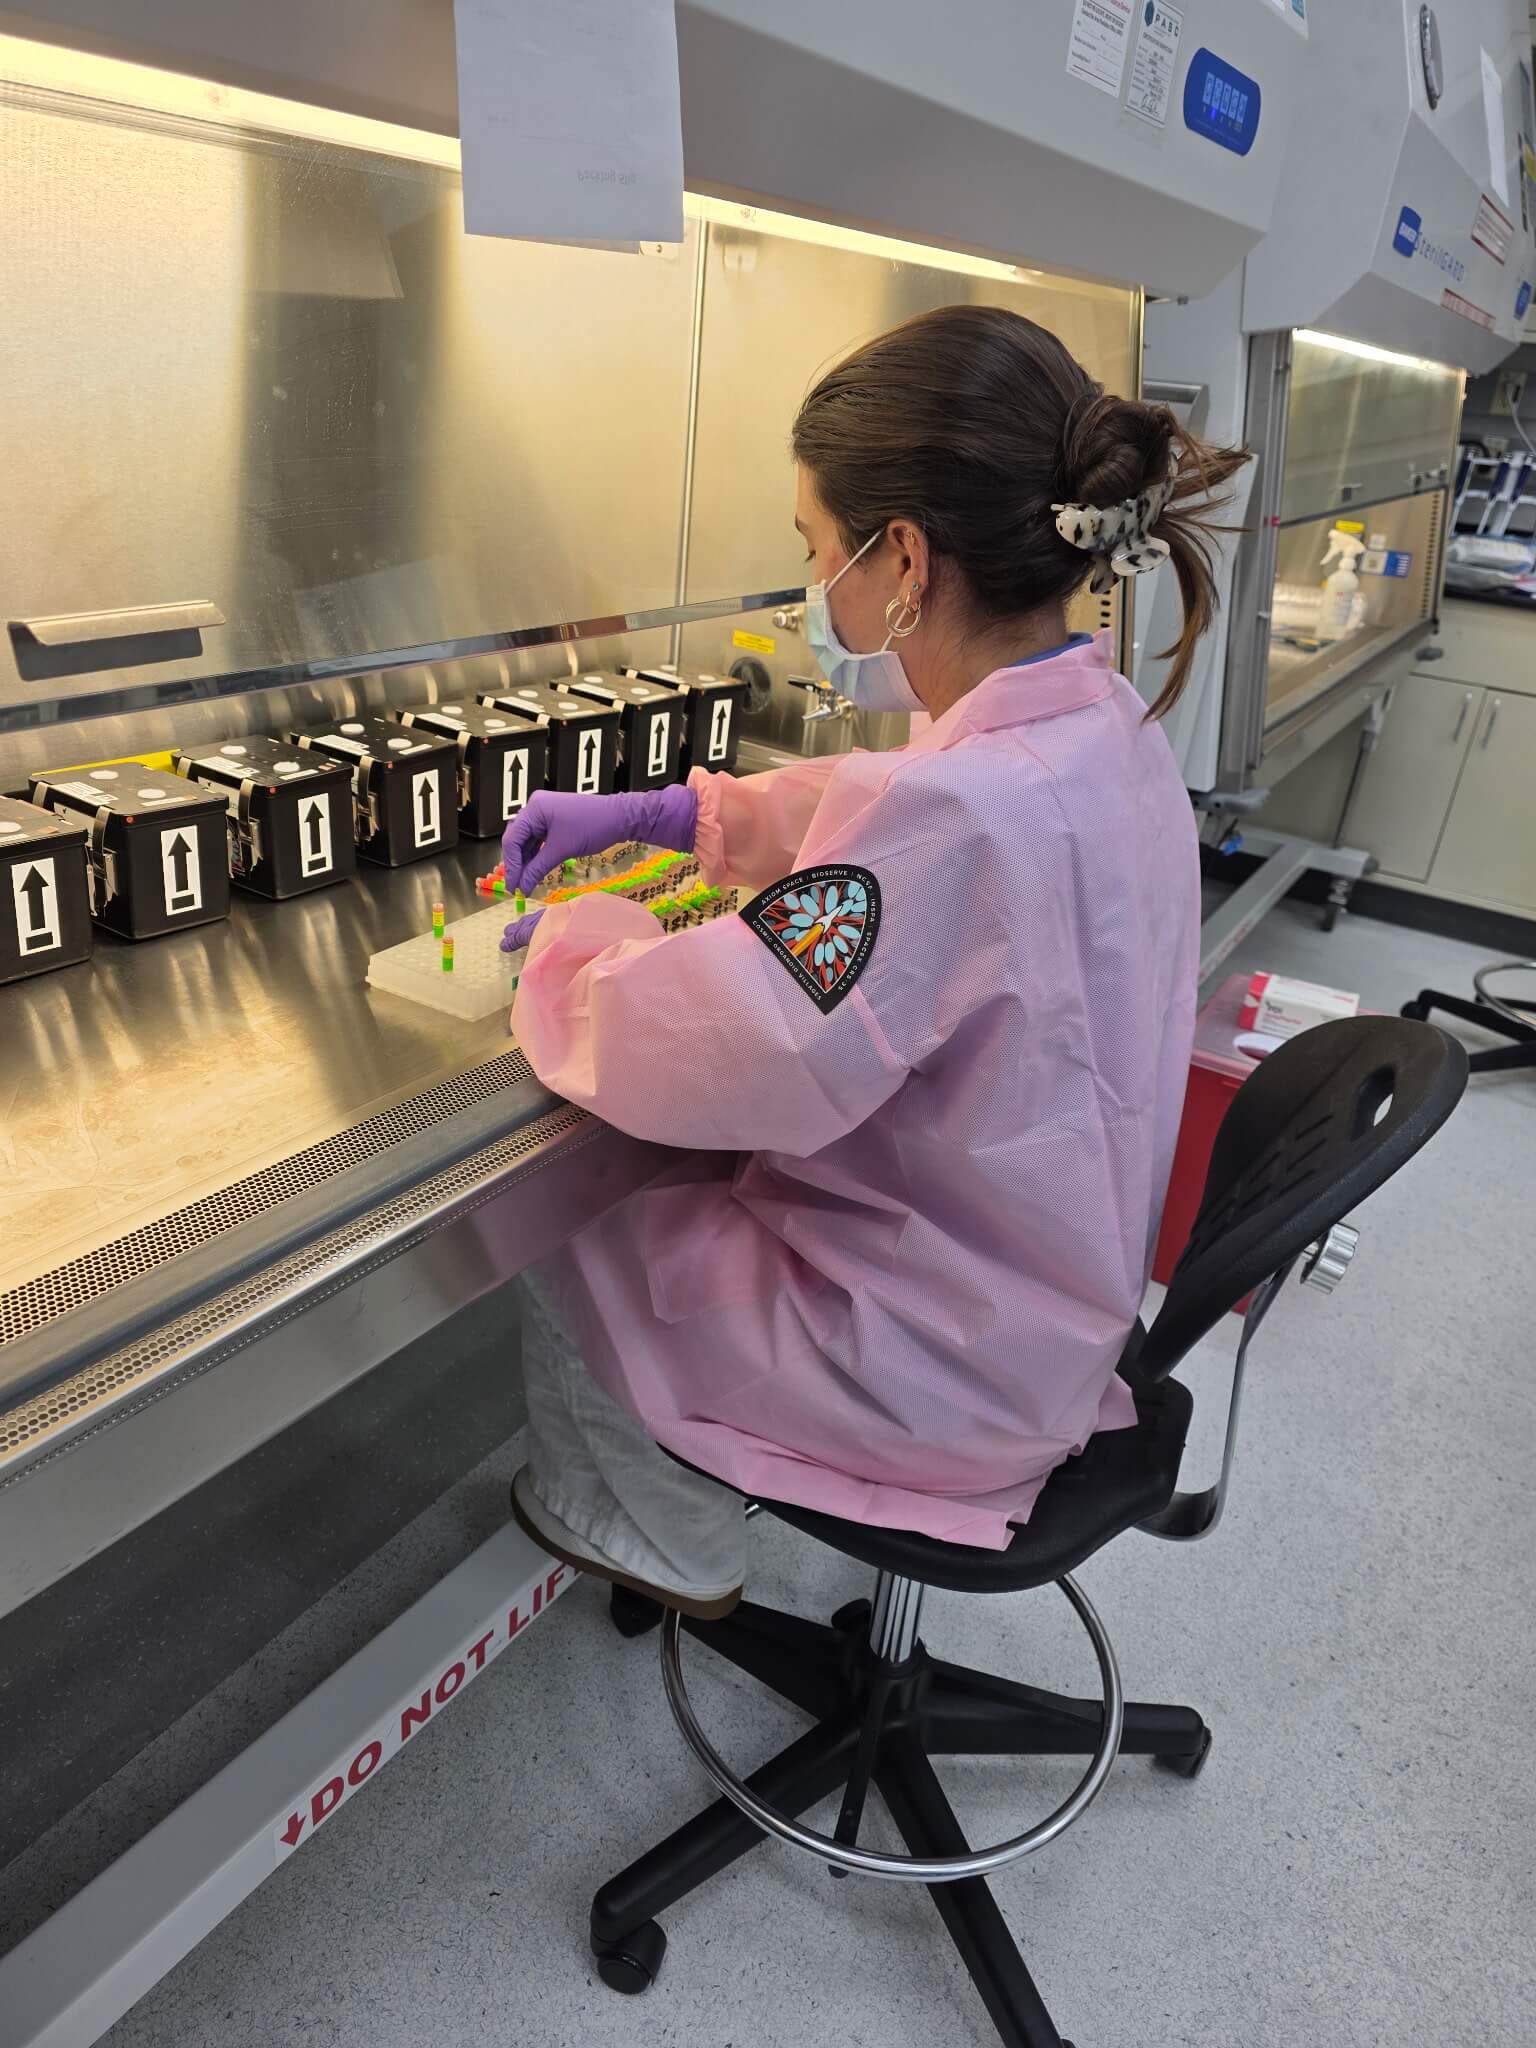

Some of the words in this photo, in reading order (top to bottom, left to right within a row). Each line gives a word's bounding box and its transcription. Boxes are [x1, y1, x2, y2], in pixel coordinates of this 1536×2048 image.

[752, 920, 773, 943] COSMIC
[773, 943, 799, 973] ORGANOID
[798, 973, 822, 1001] VILLAGES
[761, 887, 782, 906] AXIOM
[782, 877, 803, 890] SPACE
[811, 870, 848, 879] BIOSERVE
[857, 932, 872, 962] SPACEX
[311, 1740, 383, 1827] DO
[401, 1629, 494, 1742] NOT
[508, 1563, 584, 1640] LIF
